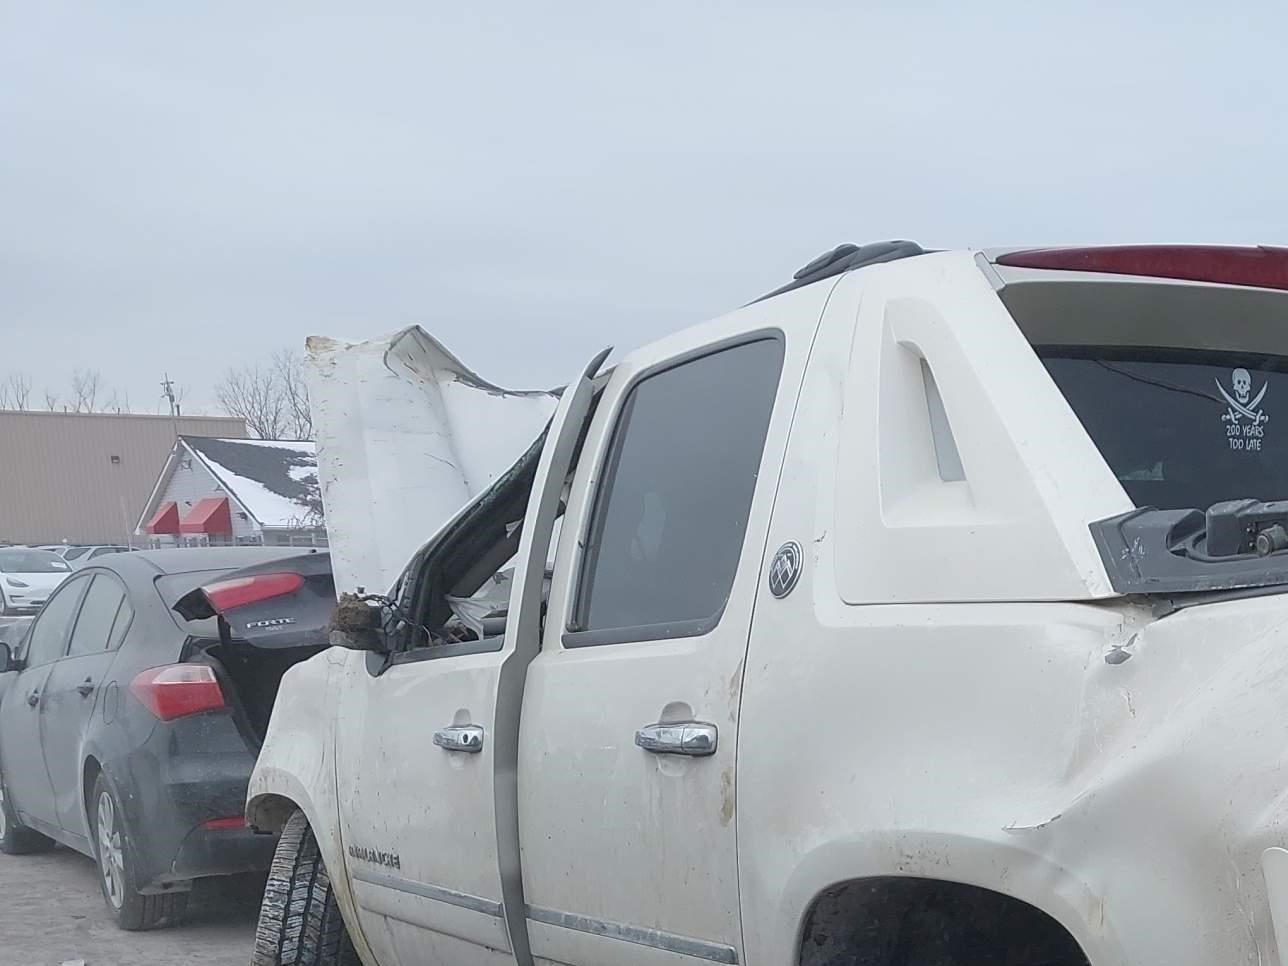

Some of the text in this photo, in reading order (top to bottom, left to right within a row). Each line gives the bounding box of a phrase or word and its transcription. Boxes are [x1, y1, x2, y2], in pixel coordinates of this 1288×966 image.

[1226, 425, 1264, 437] 200 YEARS
[1228, 438, 1262, 451] TOO LATE
[246, 617, 297, 629] FORTE
